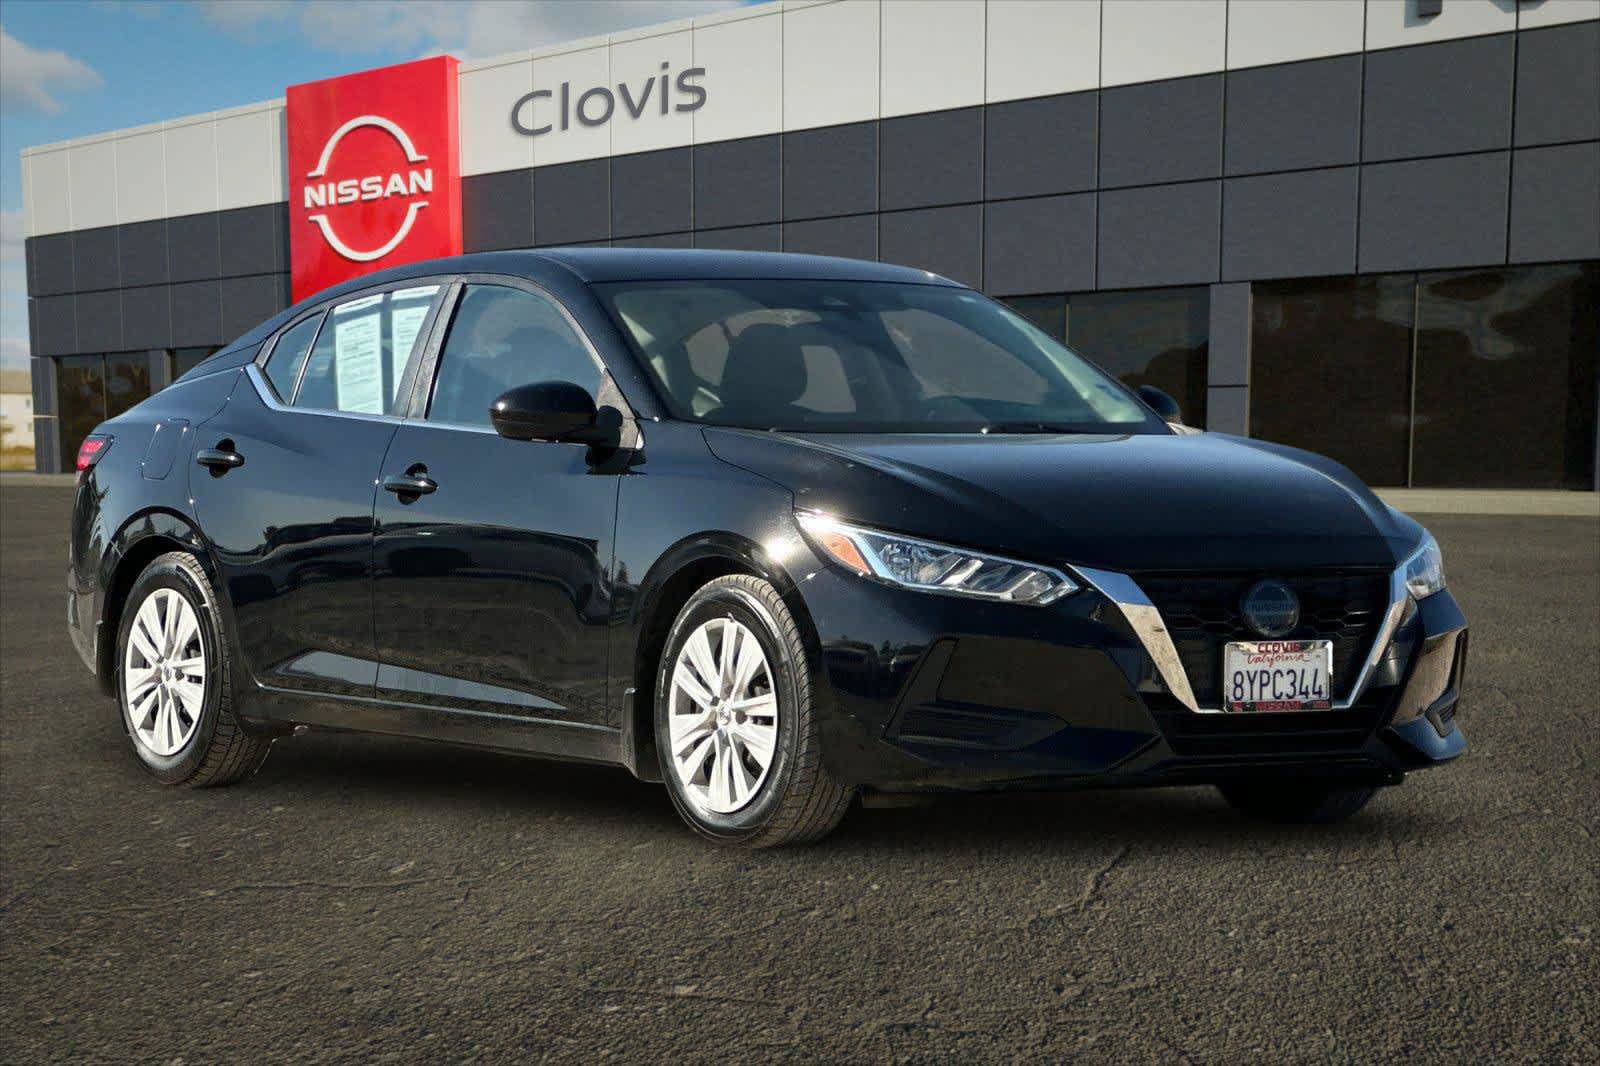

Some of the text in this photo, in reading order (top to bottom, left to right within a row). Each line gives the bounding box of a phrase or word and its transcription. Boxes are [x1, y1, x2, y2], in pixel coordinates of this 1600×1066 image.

[511, 61, 707, 136] Clovis
[304, 168, 432, 208] NISSAN
[1247, 652, 1309, 668] California
[1233, 668, 1322, 701] 8YPC344
